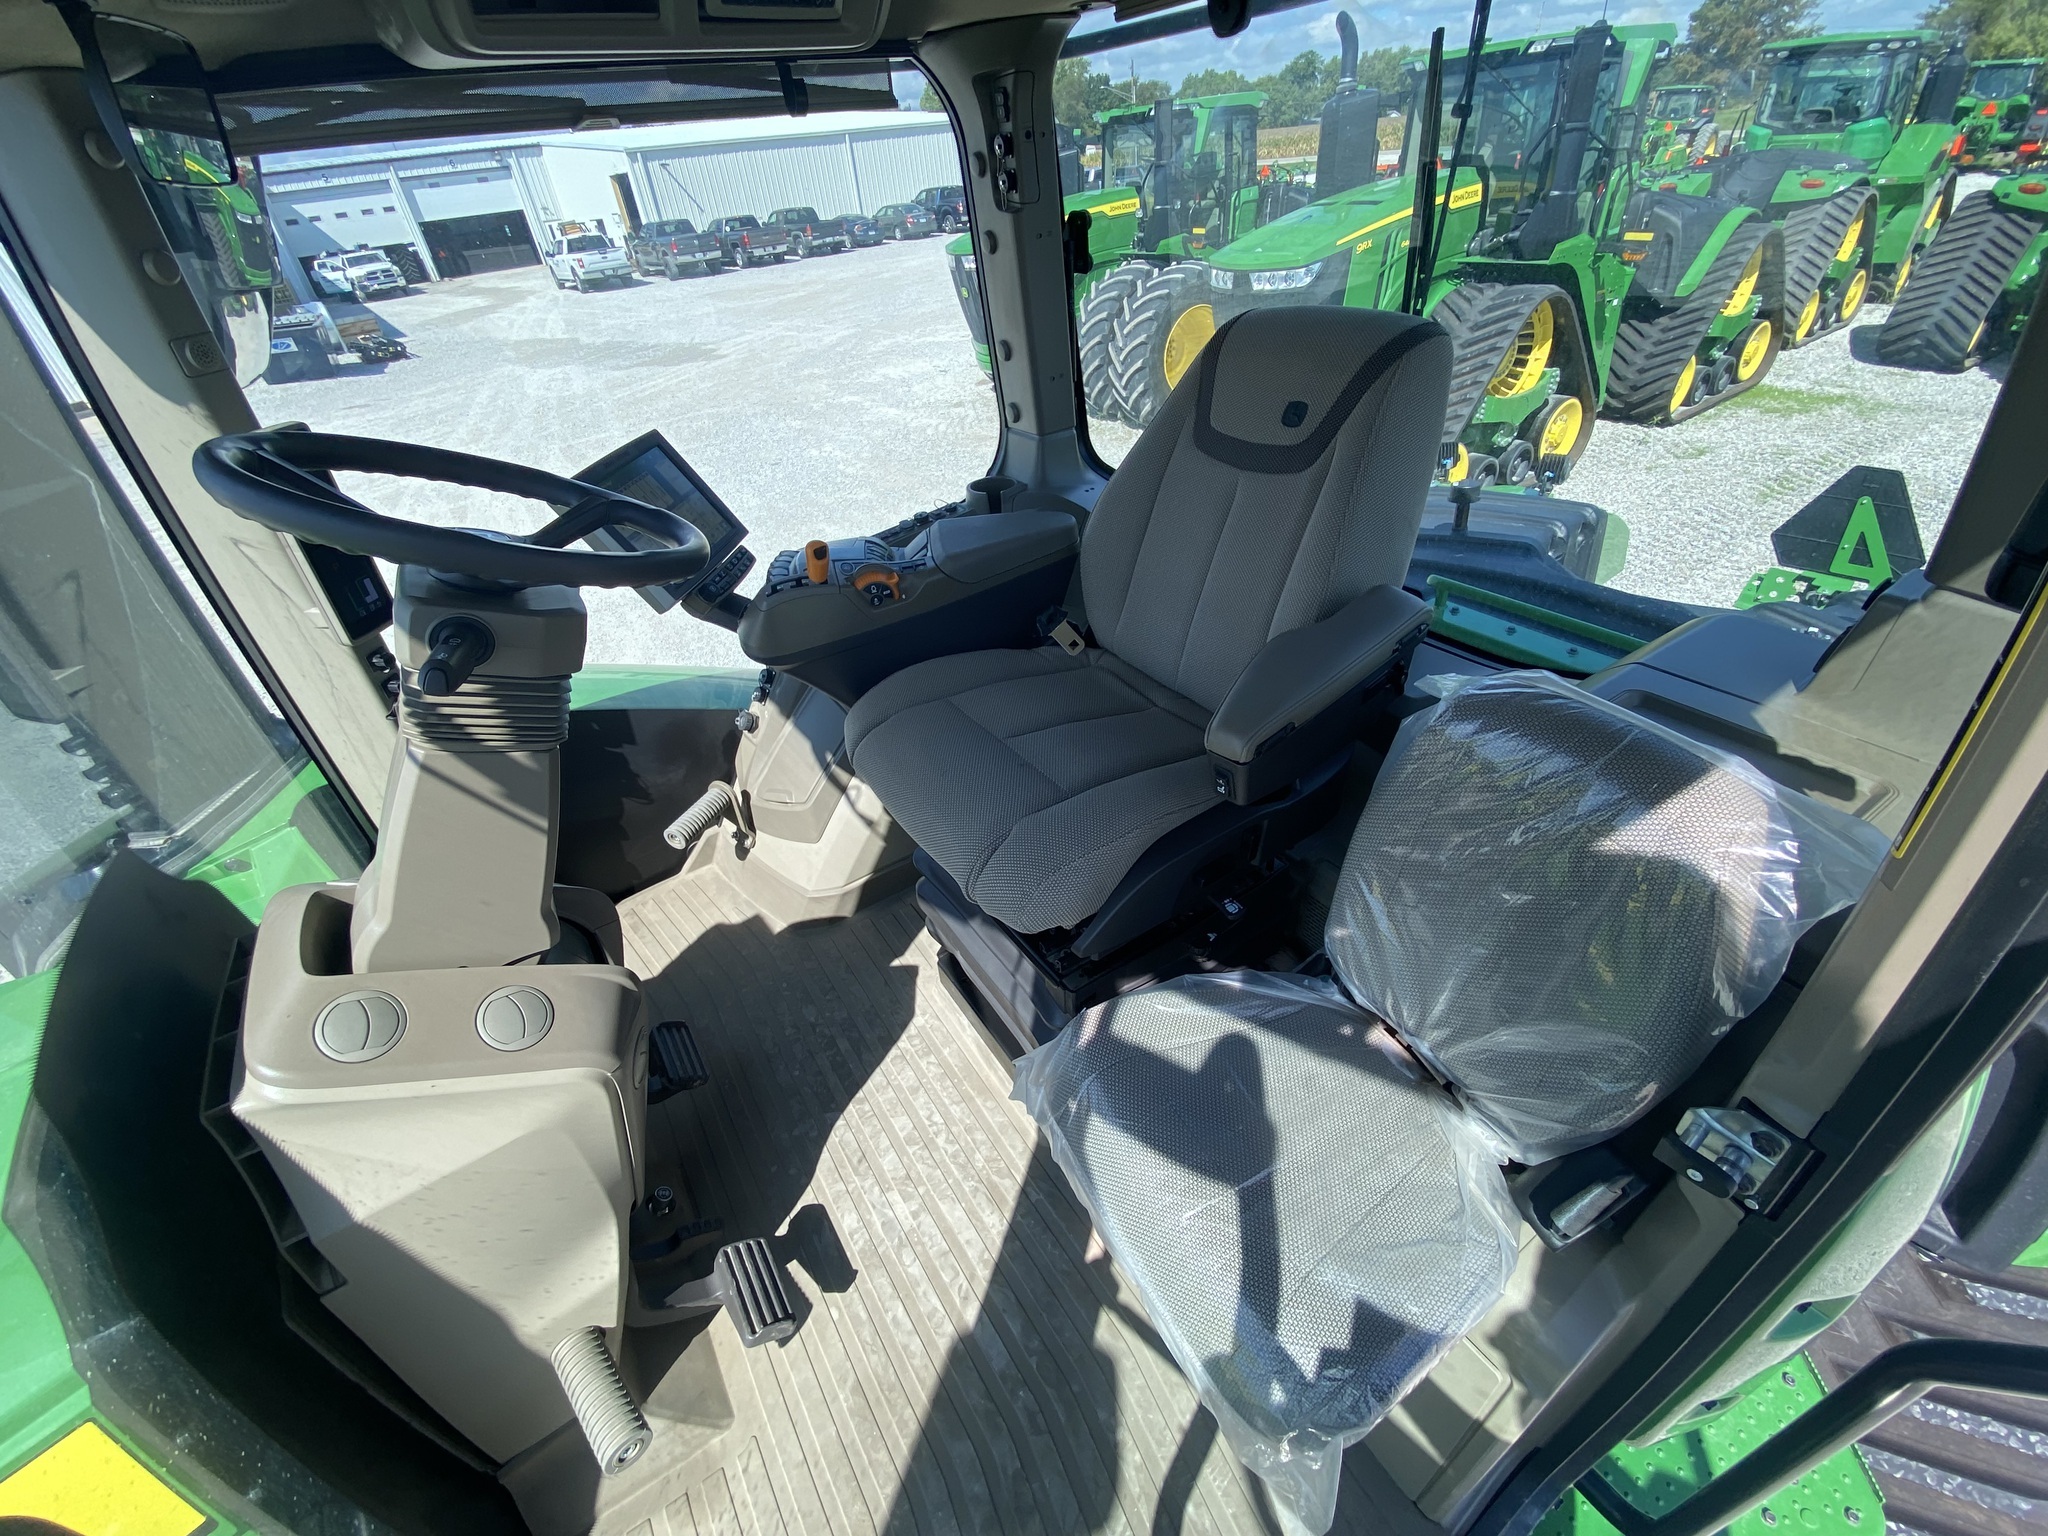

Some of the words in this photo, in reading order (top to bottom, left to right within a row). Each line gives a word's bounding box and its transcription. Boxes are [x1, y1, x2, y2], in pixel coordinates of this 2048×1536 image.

[322, 173, 329, 182] 5
[1452, 192, 1465, 204] JOHN
[1465, 189, 1479, 200] DEERE
[1121, 202, 1137, 210] DEERE
[1355, 238, 1373, 254] 9RX
[1400, 239, 1410, 248] 64
